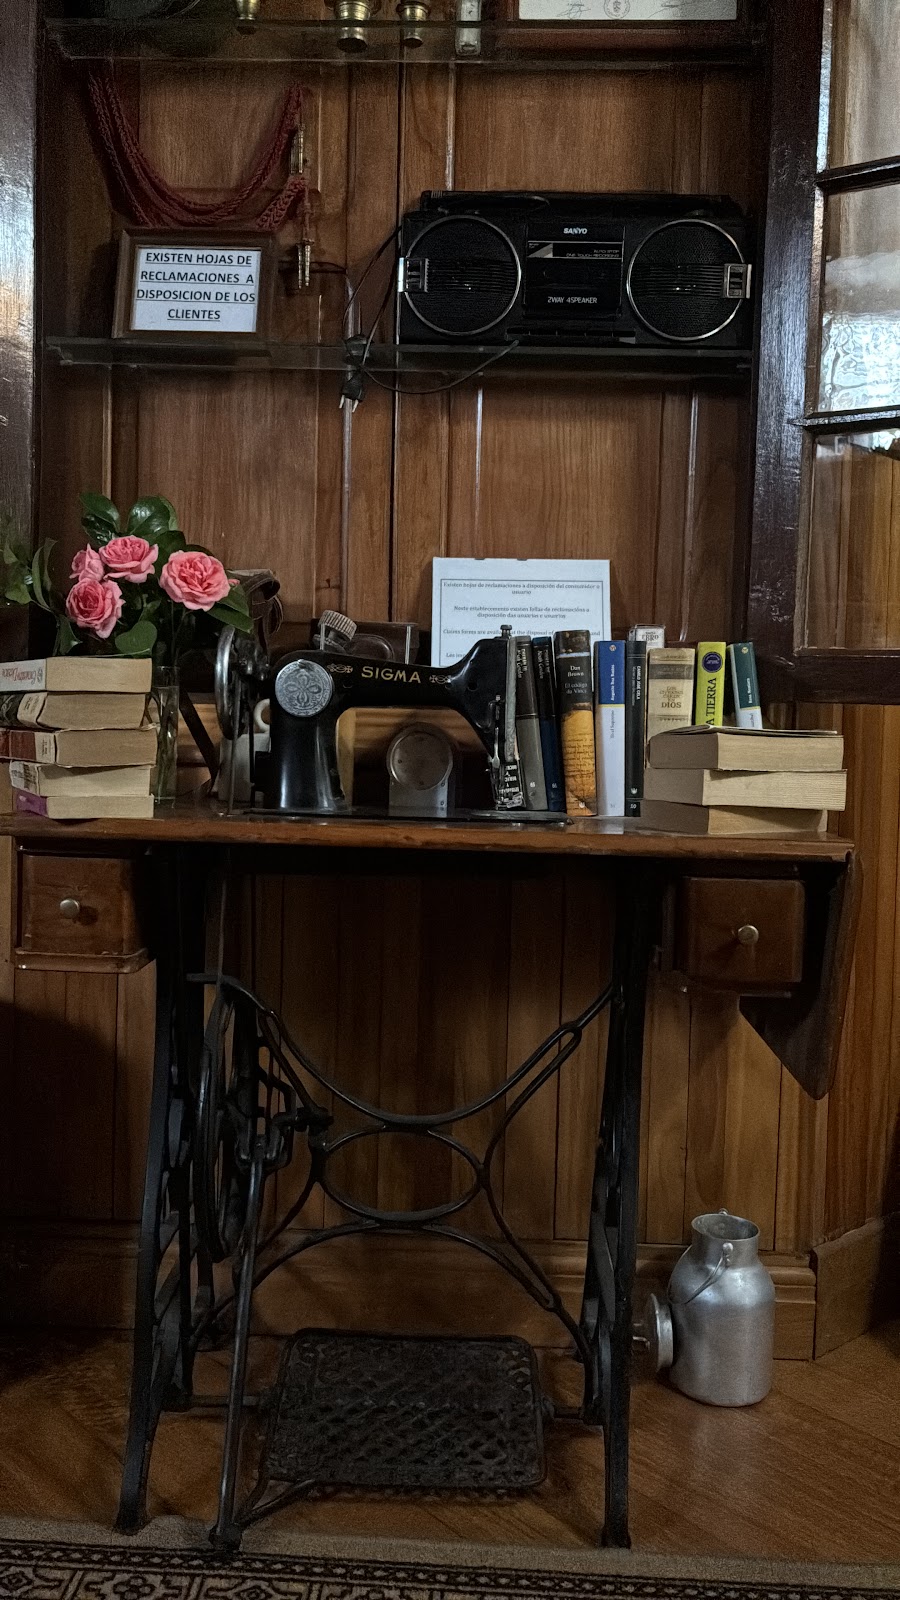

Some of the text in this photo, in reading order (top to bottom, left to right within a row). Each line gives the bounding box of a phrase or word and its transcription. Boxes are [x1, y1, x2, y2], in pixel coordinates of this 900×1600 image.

[563, 227, 588, 235] SANYO
[145, 252, 252, 265] EXISTEN HOJAS DE
[140, 270, 254, 284] RECLAMACIONES A
[136, 289, 256, 302] DISPOSICION DE LOS
[167, 308, 221, 320] CLIENTES
[361, 665, 422, 684] SIGMA
[706, 678, 716, 717] TIERRA
